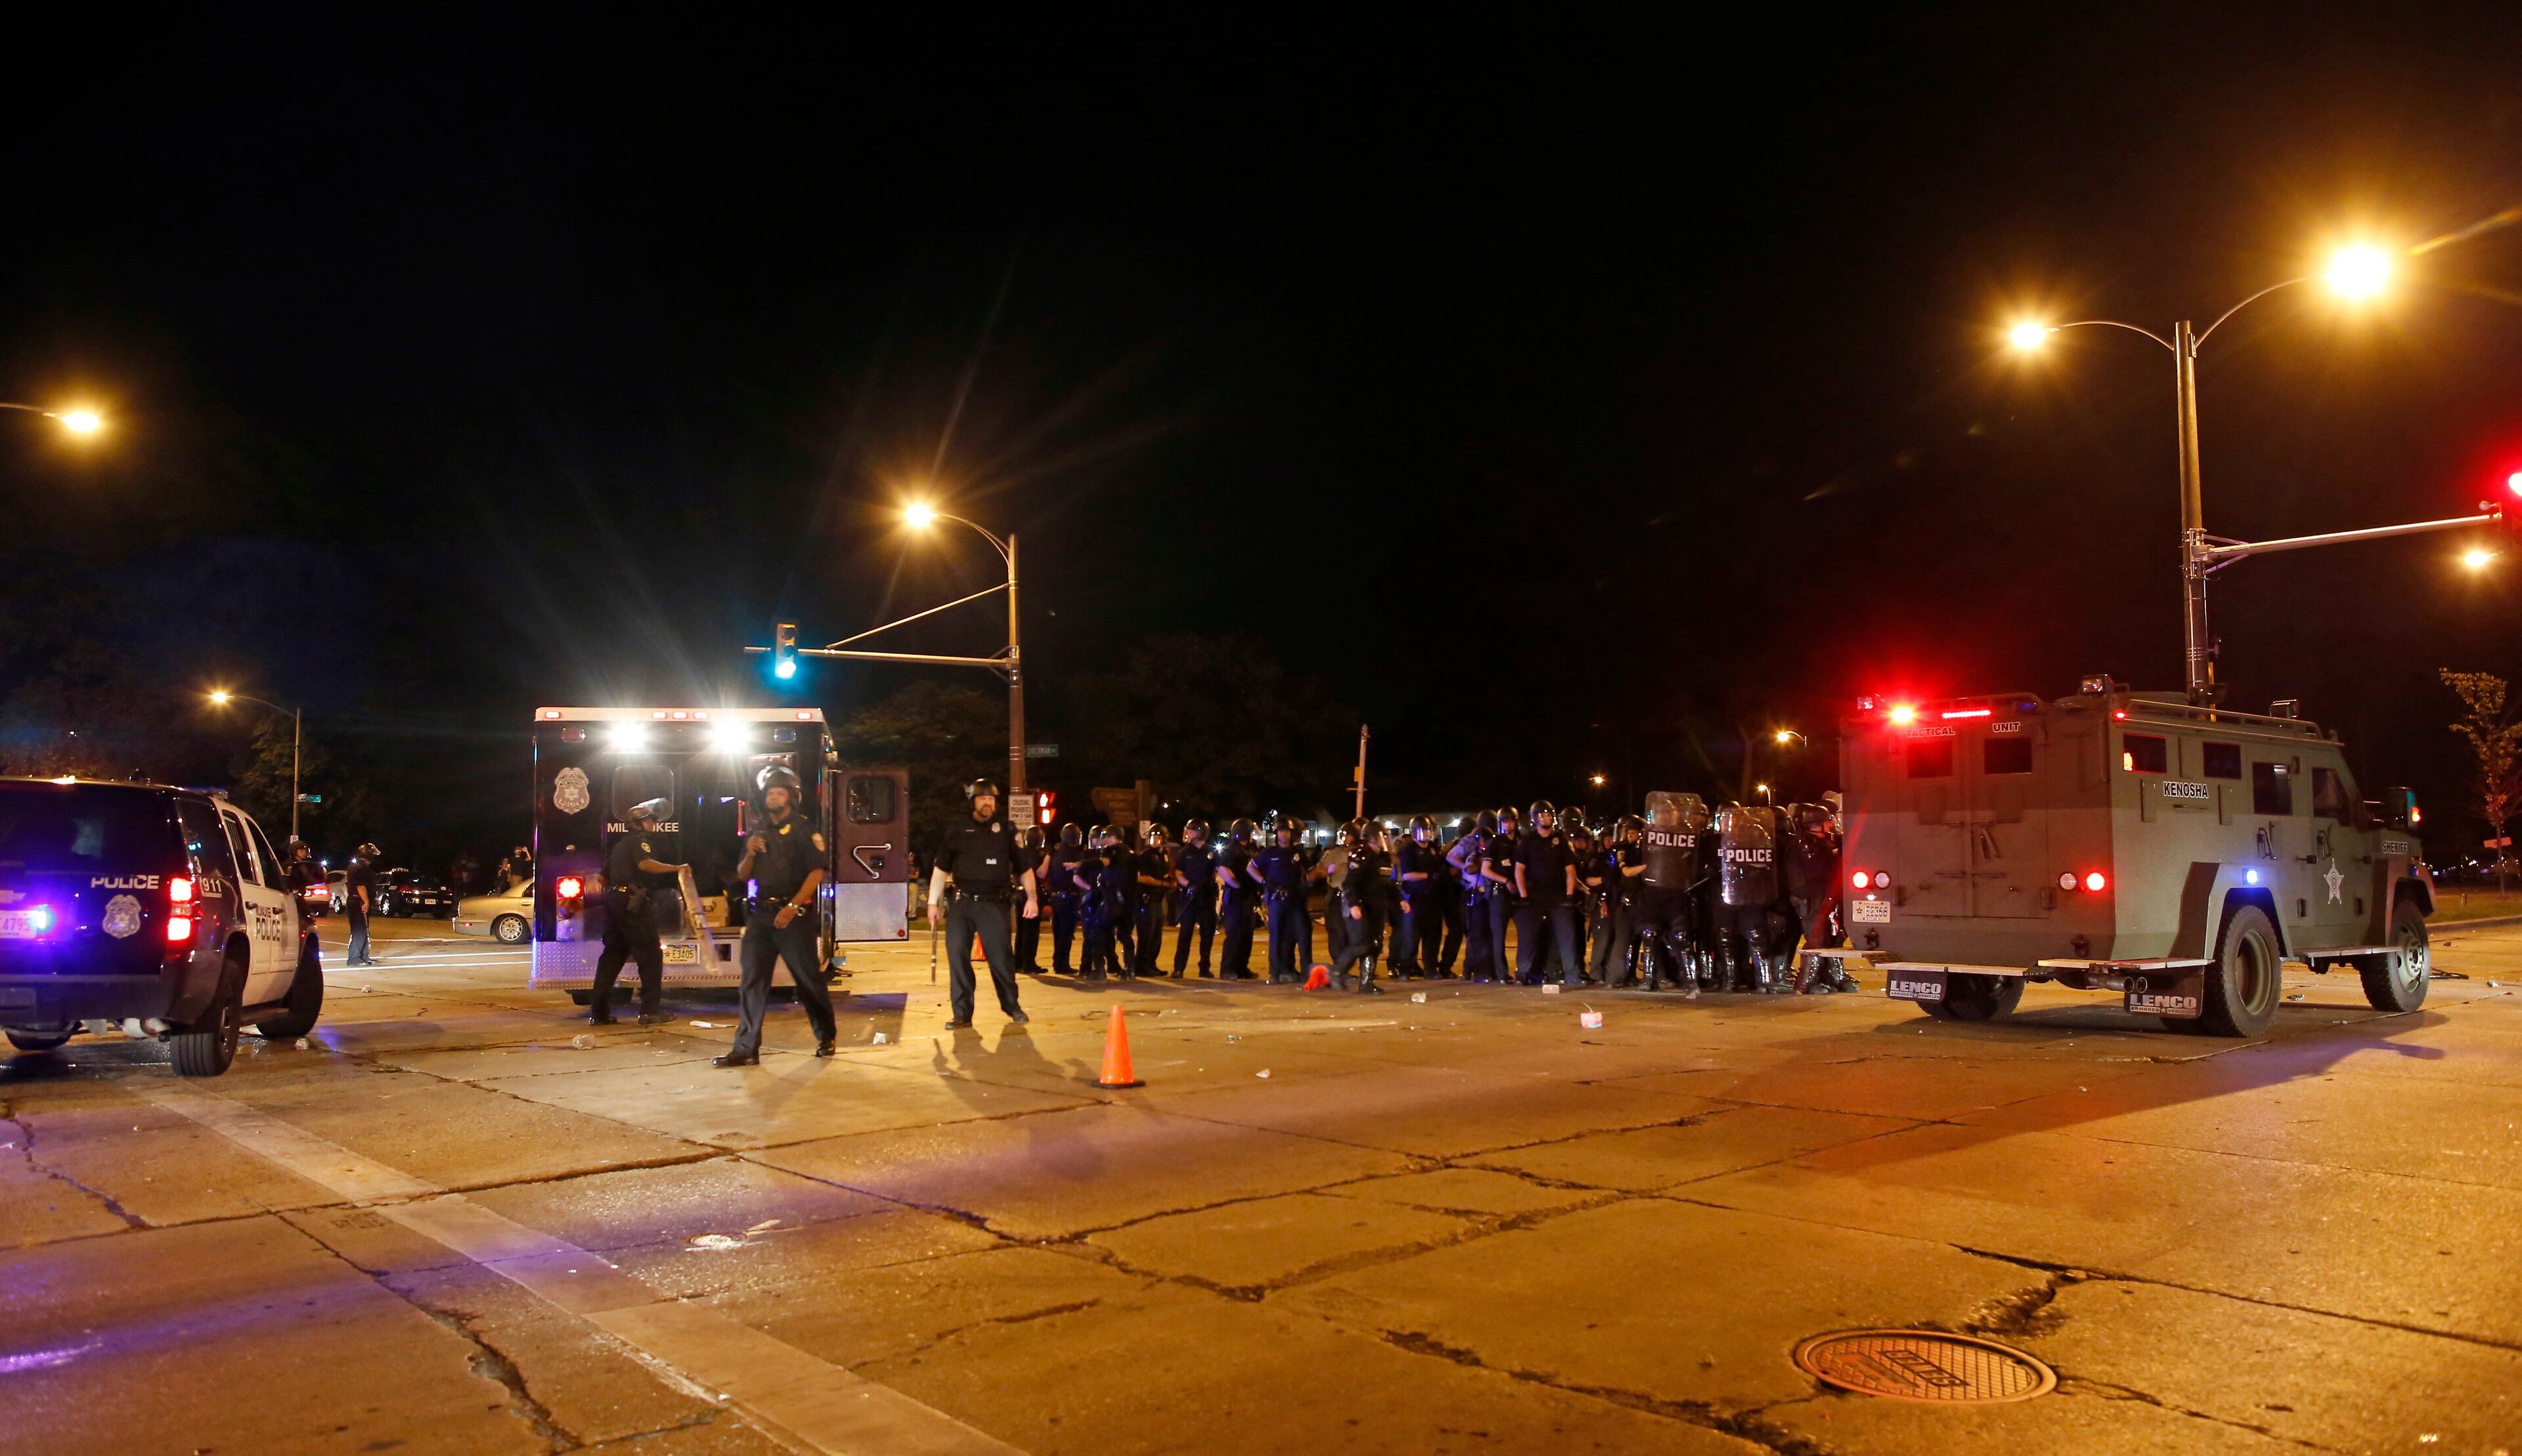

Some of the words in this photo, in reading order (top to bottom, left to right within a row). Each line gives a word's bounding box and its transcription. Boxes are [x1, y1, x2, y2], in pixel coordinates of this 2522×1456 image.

[1907, 726, 1955, 738] TACTICAL
[1992, 722, 2020, 732] UNIT
[2163, 781, 2209, 799] KENOSHA
[606, 822, 679, 833] MILKEE
[1647, 831, 1695, 848] POLICE
[2382, 841, 2408, 854] SHERIFF
[1726, 849, 1773, 862] POLICE
[91, 875, 160, 889] POLICE
[202, 877, 222, 893] 911
[255, 917, 280, 941] POLICE
[1890, 980, 1941, 994] LENCO
[2130, 994, 2196, 1009] LENCO
